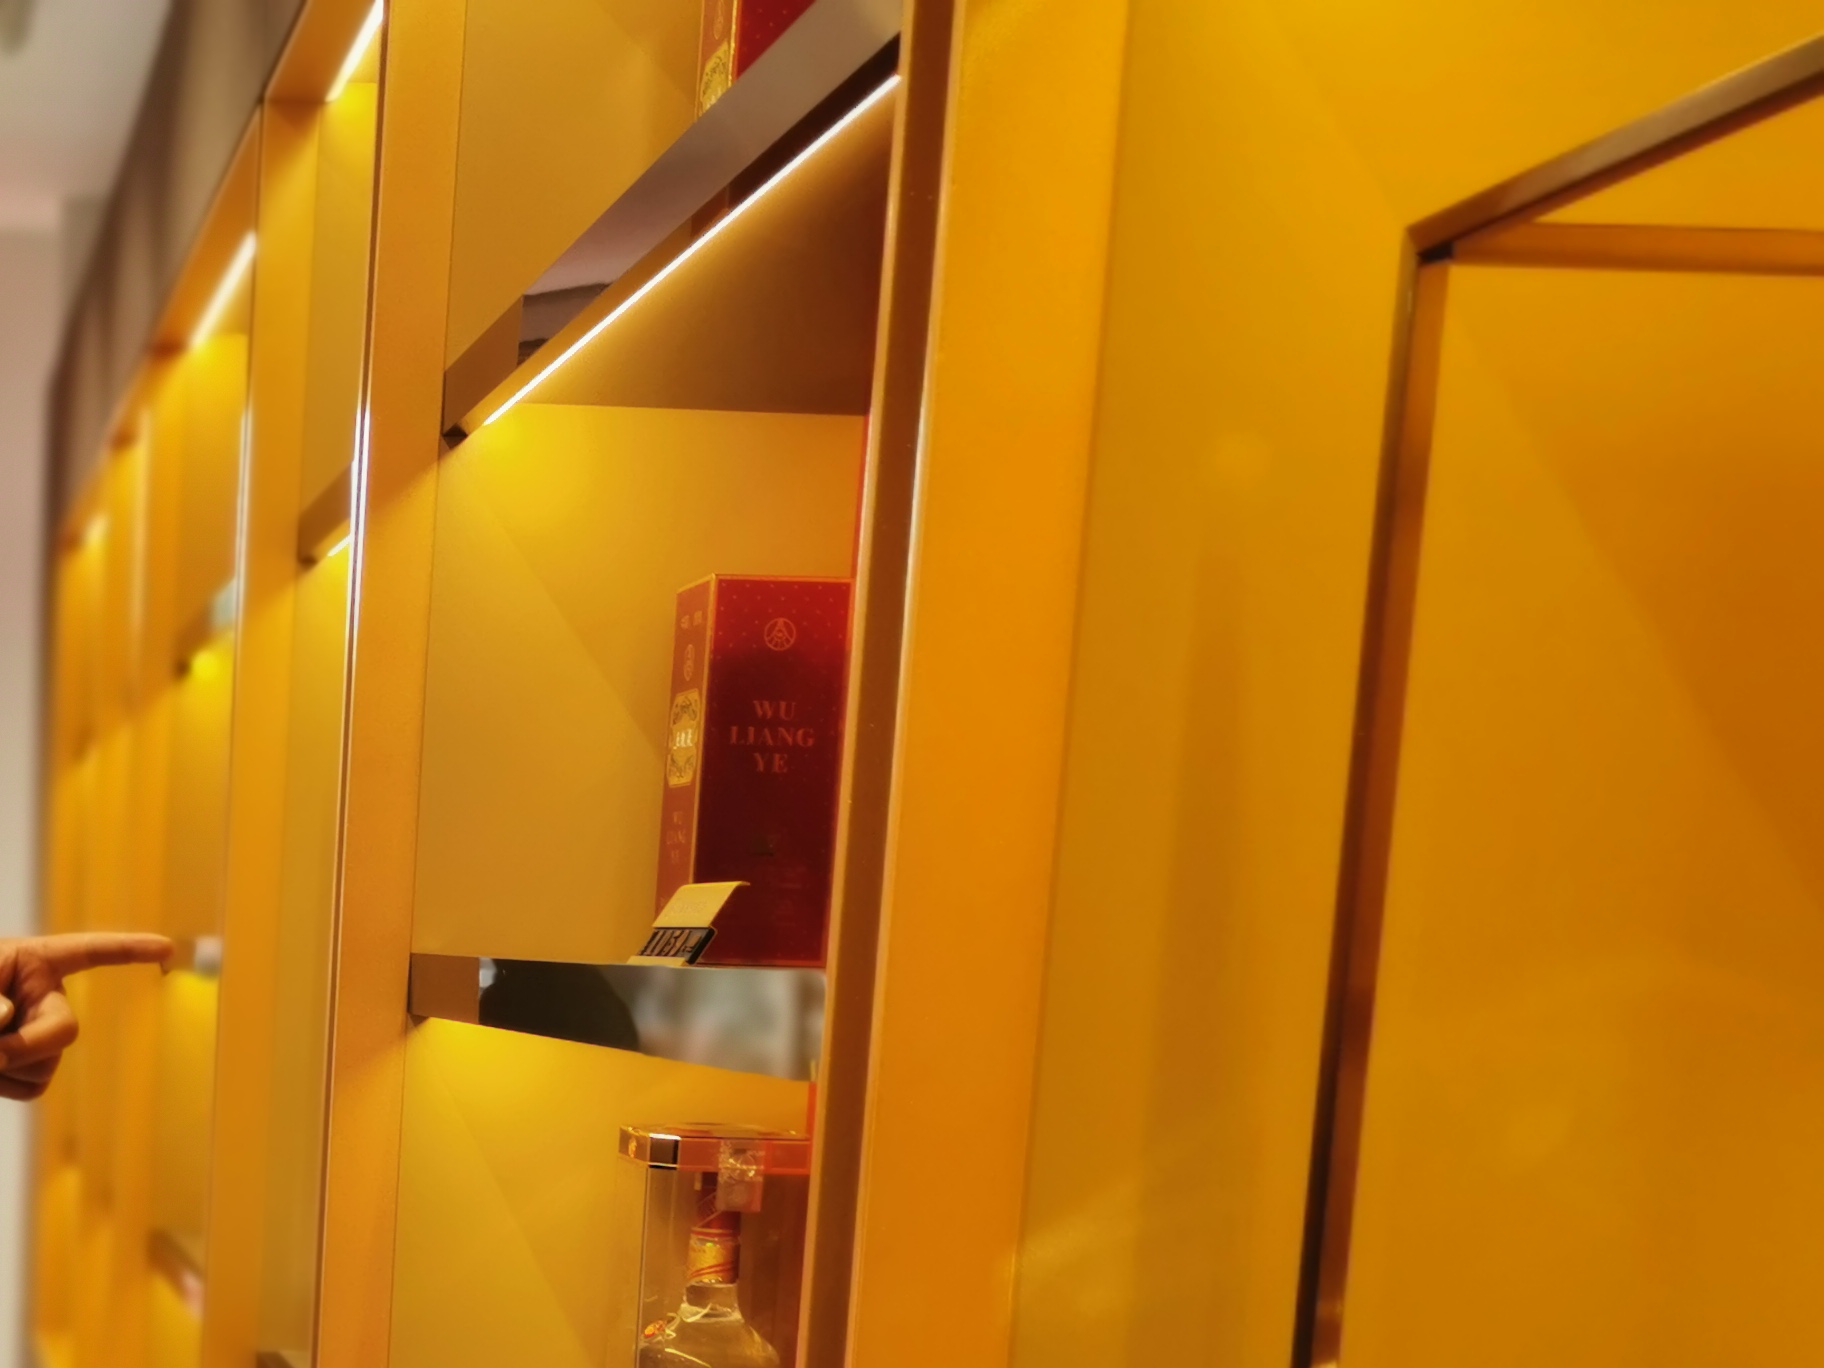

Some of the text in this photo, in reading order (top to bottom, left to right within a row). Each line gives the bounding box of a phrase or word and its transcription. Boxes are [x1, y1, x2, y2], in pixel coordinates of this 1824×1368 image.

[753, 700, 796, 720] WU
[729, 726, 815, 747] LIANG
[753, 752, 788, 773] YE
